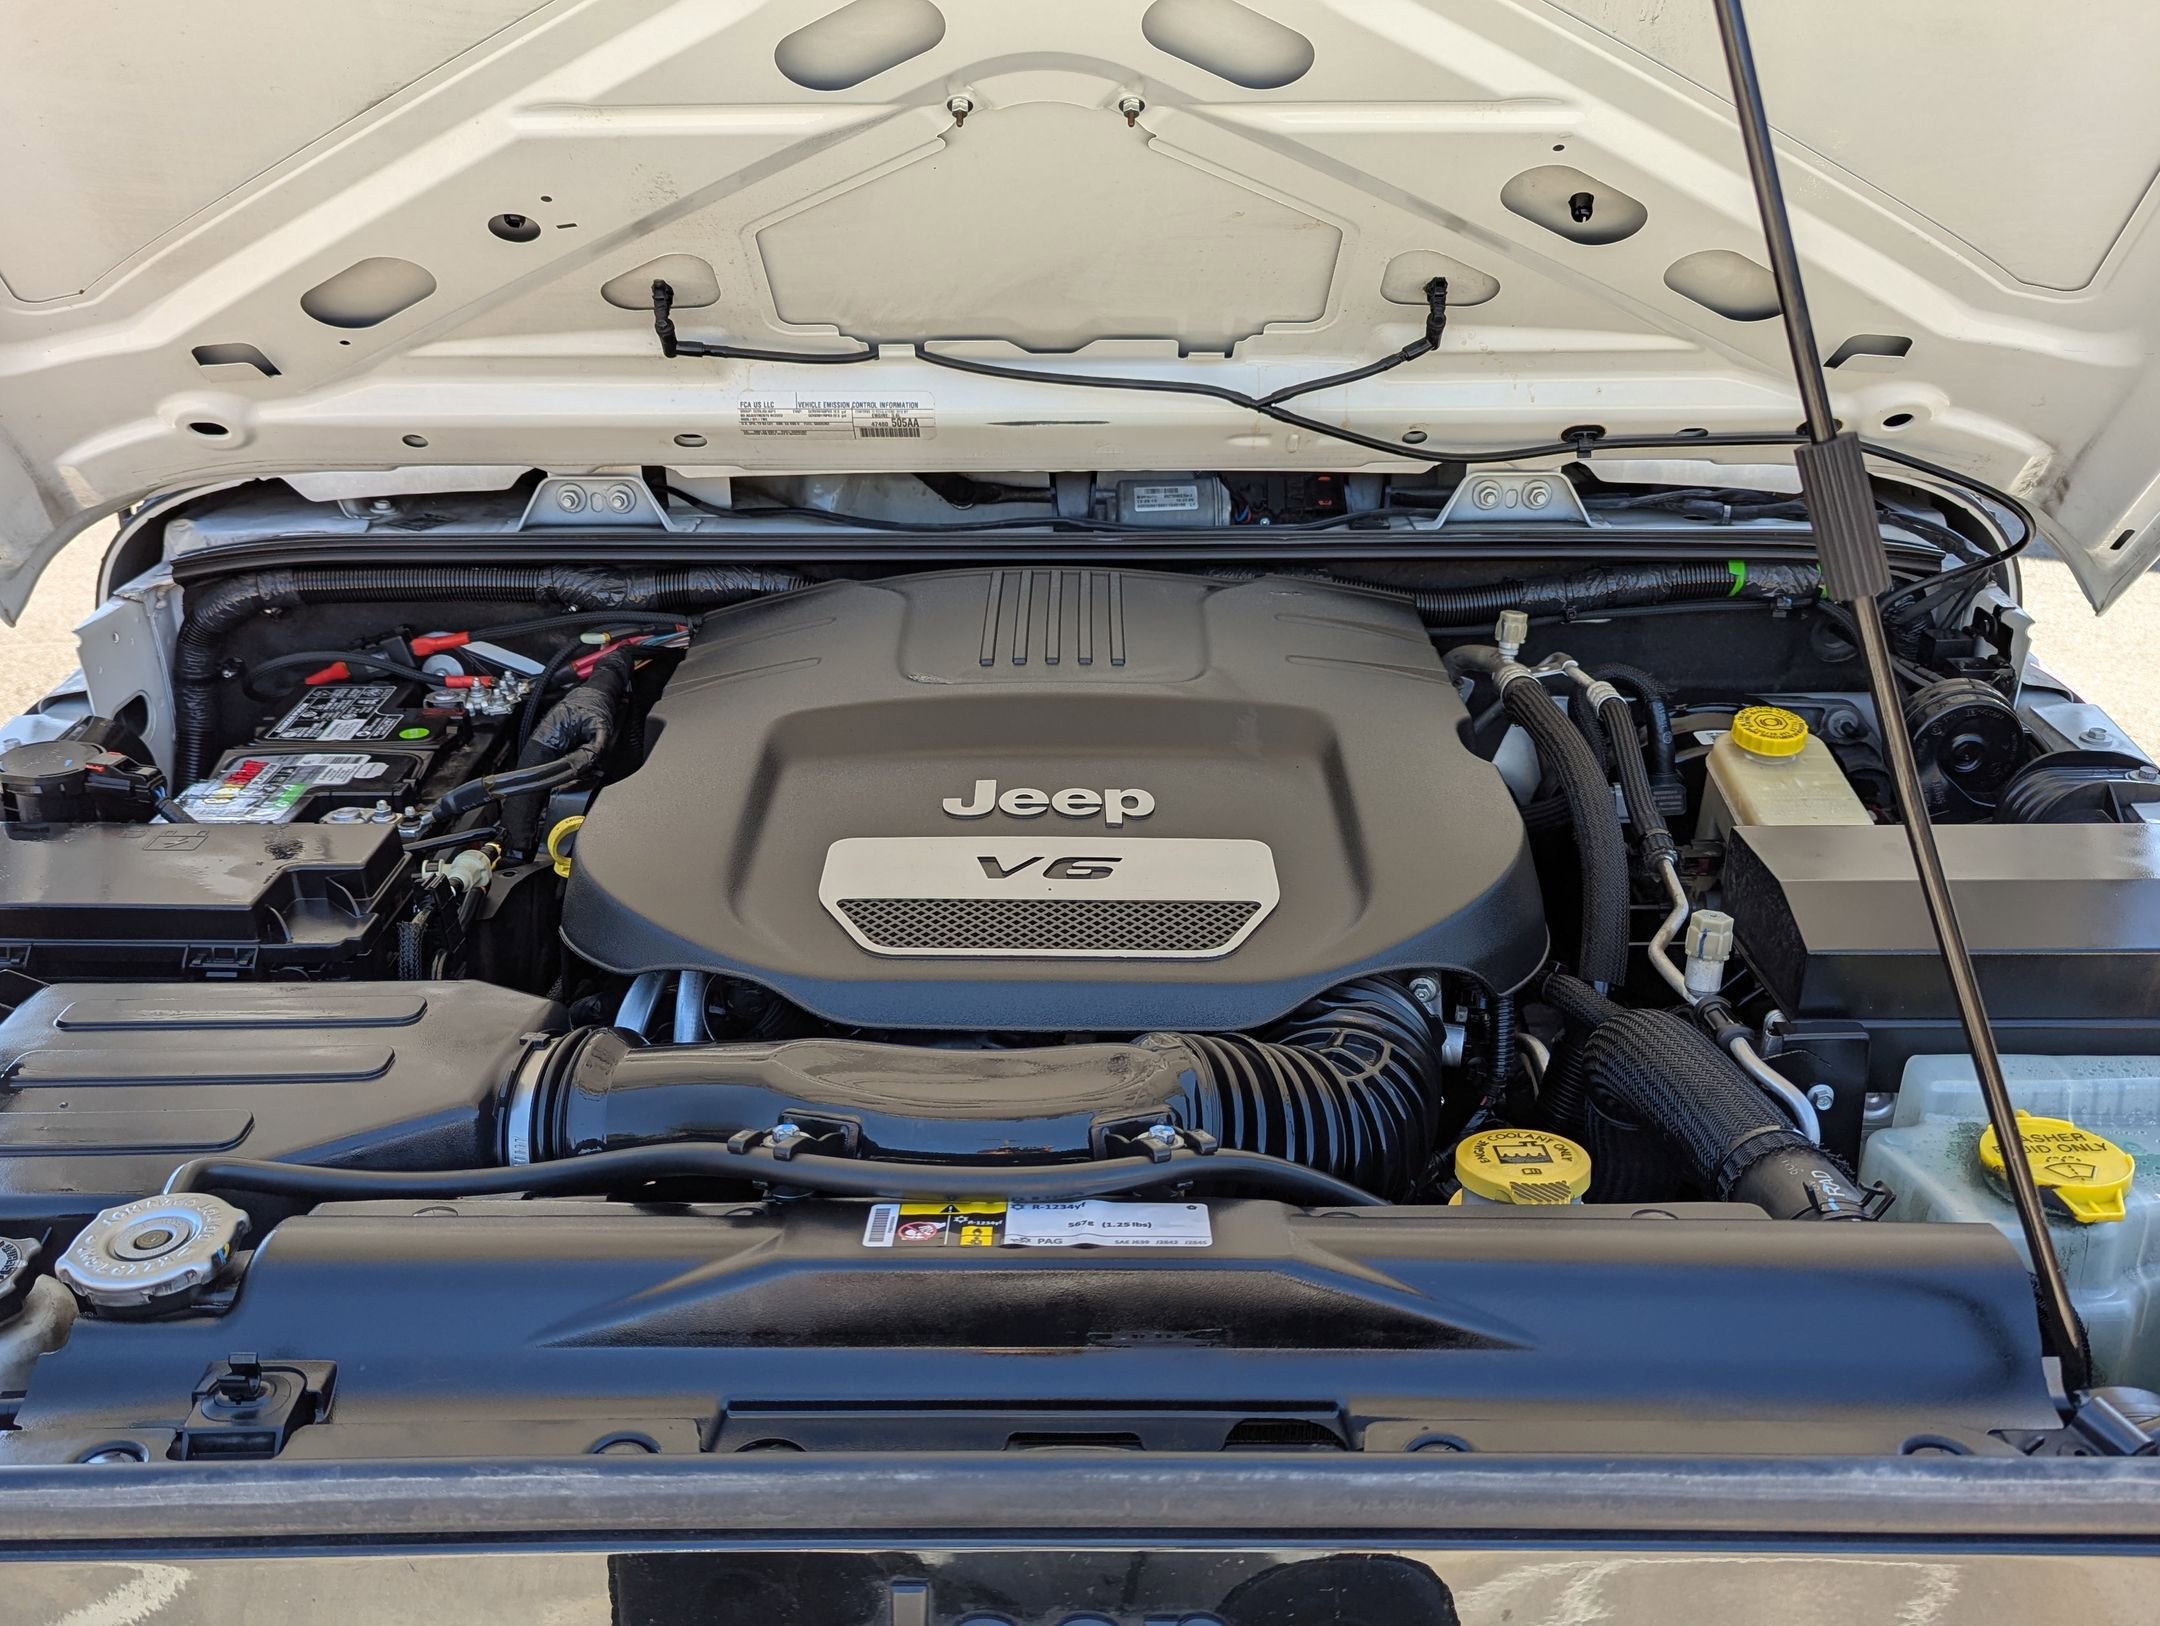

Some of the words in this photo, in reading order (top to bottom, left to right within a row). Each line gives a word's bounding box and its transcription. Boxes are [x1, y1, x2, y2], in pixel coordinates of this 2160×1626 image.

[740, 401, 752, 409] FCA
[753, 401, 762, 409] US
[763, 401, 775, 409] LLC
[798, 401, 821, 409] VEHICLE
[823, 401, 850, 409] EMISSION
[852, 401, 877, 409] CONTROL
[880, 401, 919, 409] INFORMATION
[891, 417, 920, 428] 505AA
[942, 779, 1156, 828] Jeep
[976, 856, 1124, 881] V6
[2020, 1132, 2087, 1143] ASHER
[1473, 1140, 1491, 1164] ENGINE
[1487, 1132, 1555, 1145] COOLANT
[1553, 1143, 1574, 1163] ONLY
[2056, 1142, 2108, 1153] ONLY
[1032, 1201, 1086, 1210] R-1234yf
[1037, 1237, 1063, 1245] PAG
